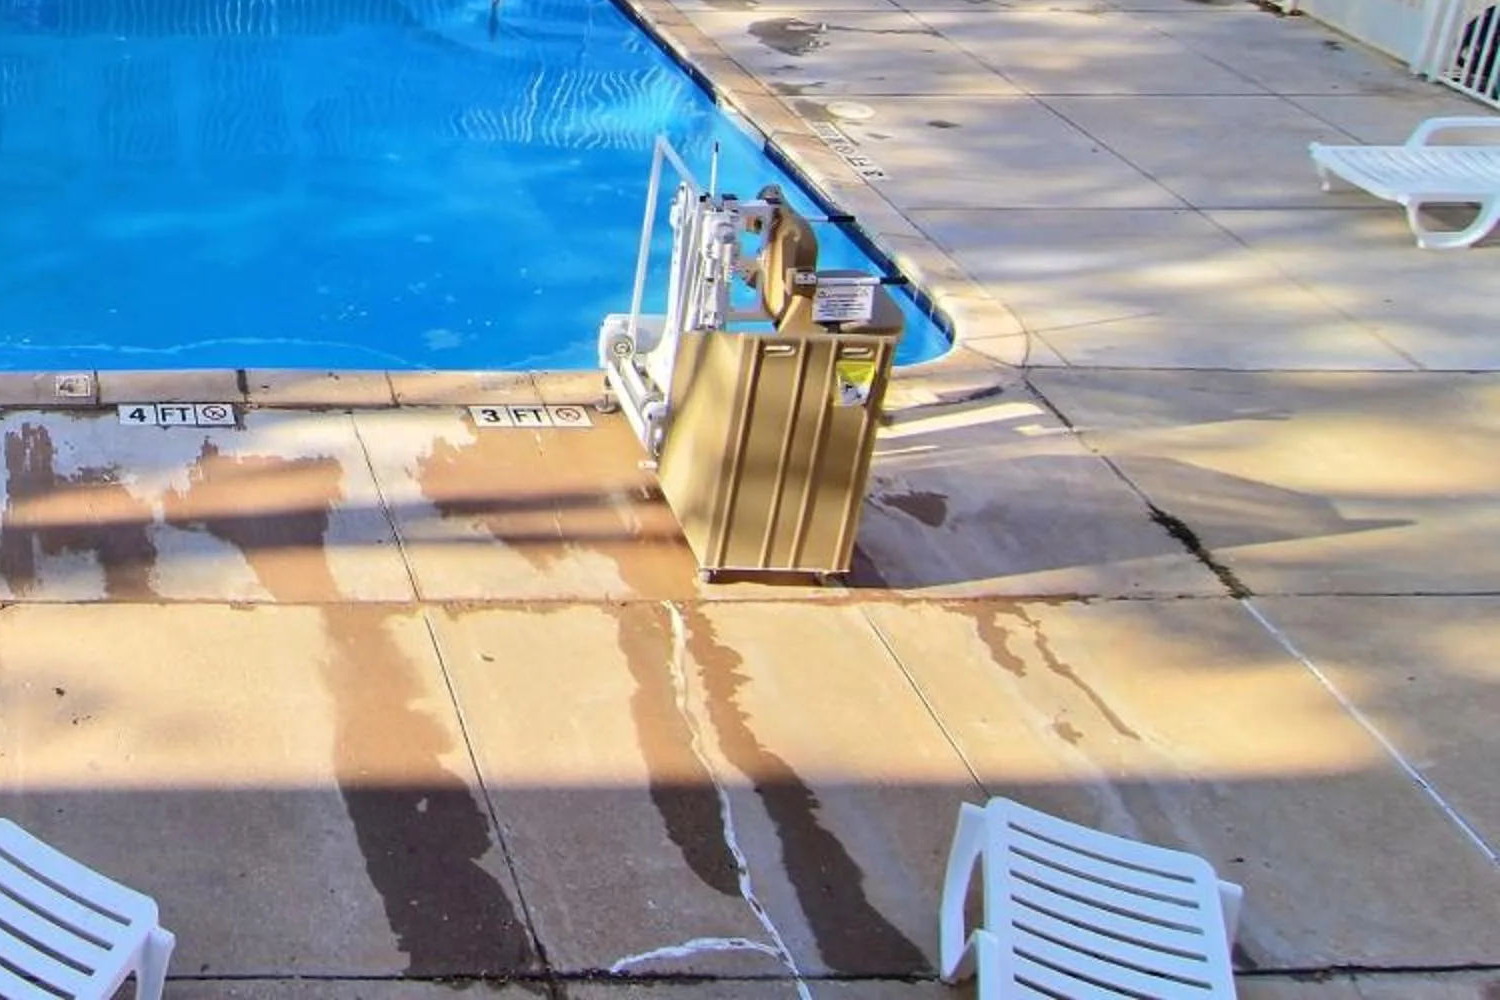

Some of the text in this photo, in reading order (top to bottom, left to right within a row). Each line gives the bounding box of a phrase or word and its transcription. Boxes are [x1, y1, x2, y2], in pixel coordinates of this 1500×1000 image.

[129, 407, 190, 422] 4 FT
[481, 408, 543, 423] 3 FT
